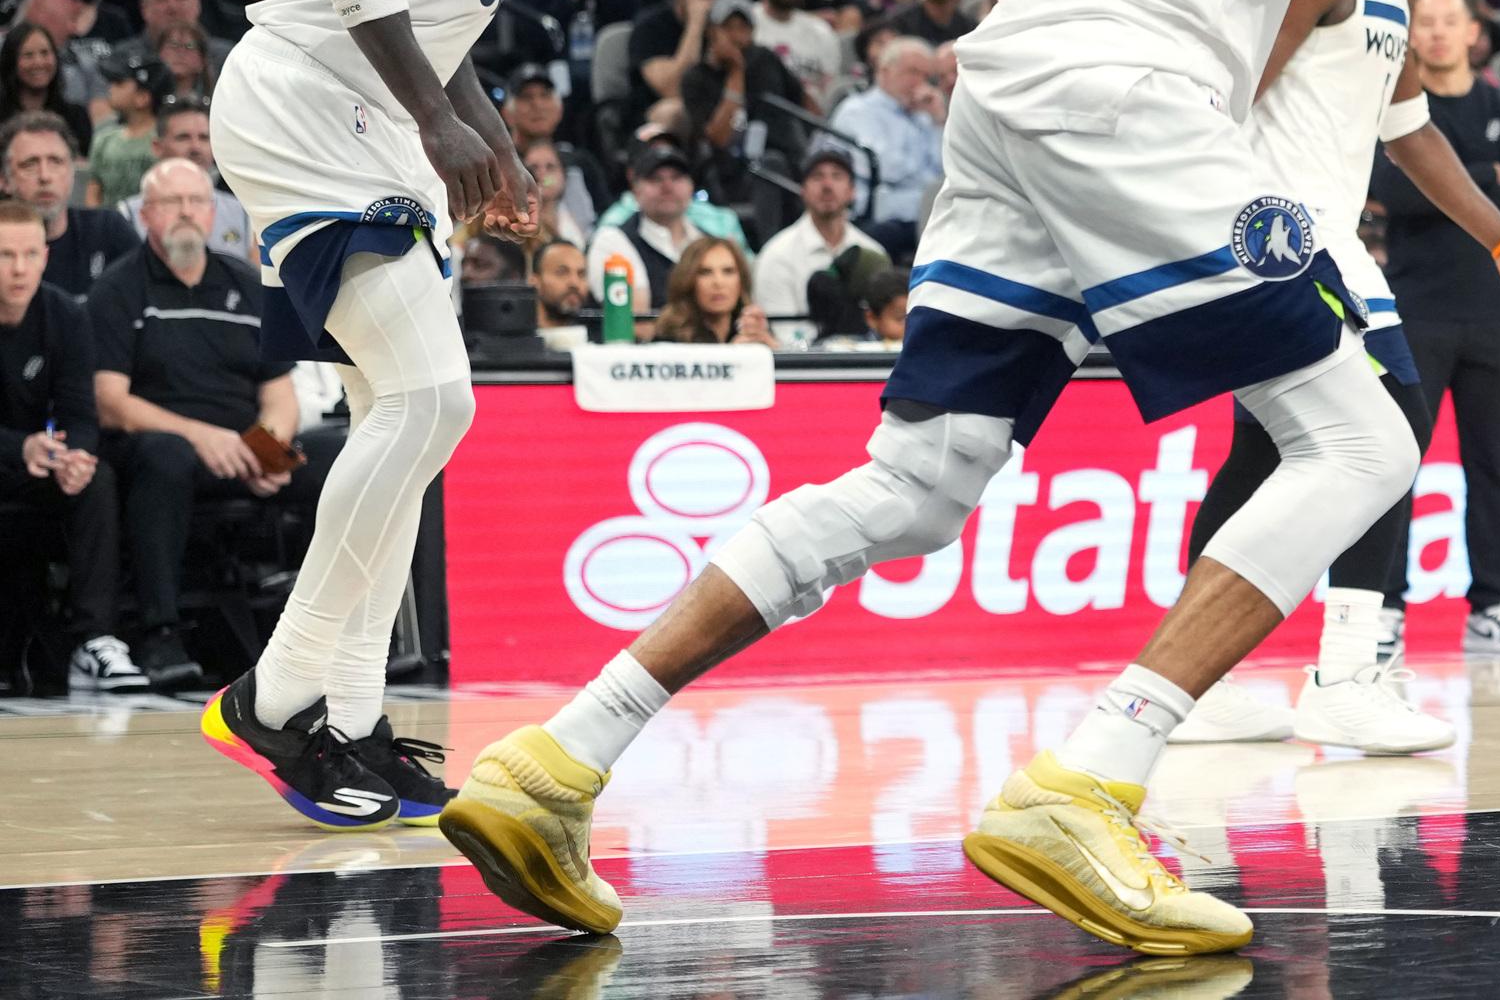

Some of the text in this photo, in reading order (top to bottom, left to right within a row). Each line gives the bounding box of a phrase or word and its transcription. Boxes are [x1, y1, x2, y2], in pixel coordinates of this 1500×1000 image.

[340, 3, 361, 17] ayce
[1232, 197, 1313, 265] MINNESOTA TIMBERWOLVES
[610, 363, 736, 381] GATORADE
[859, 425, 1209, 619] tat
